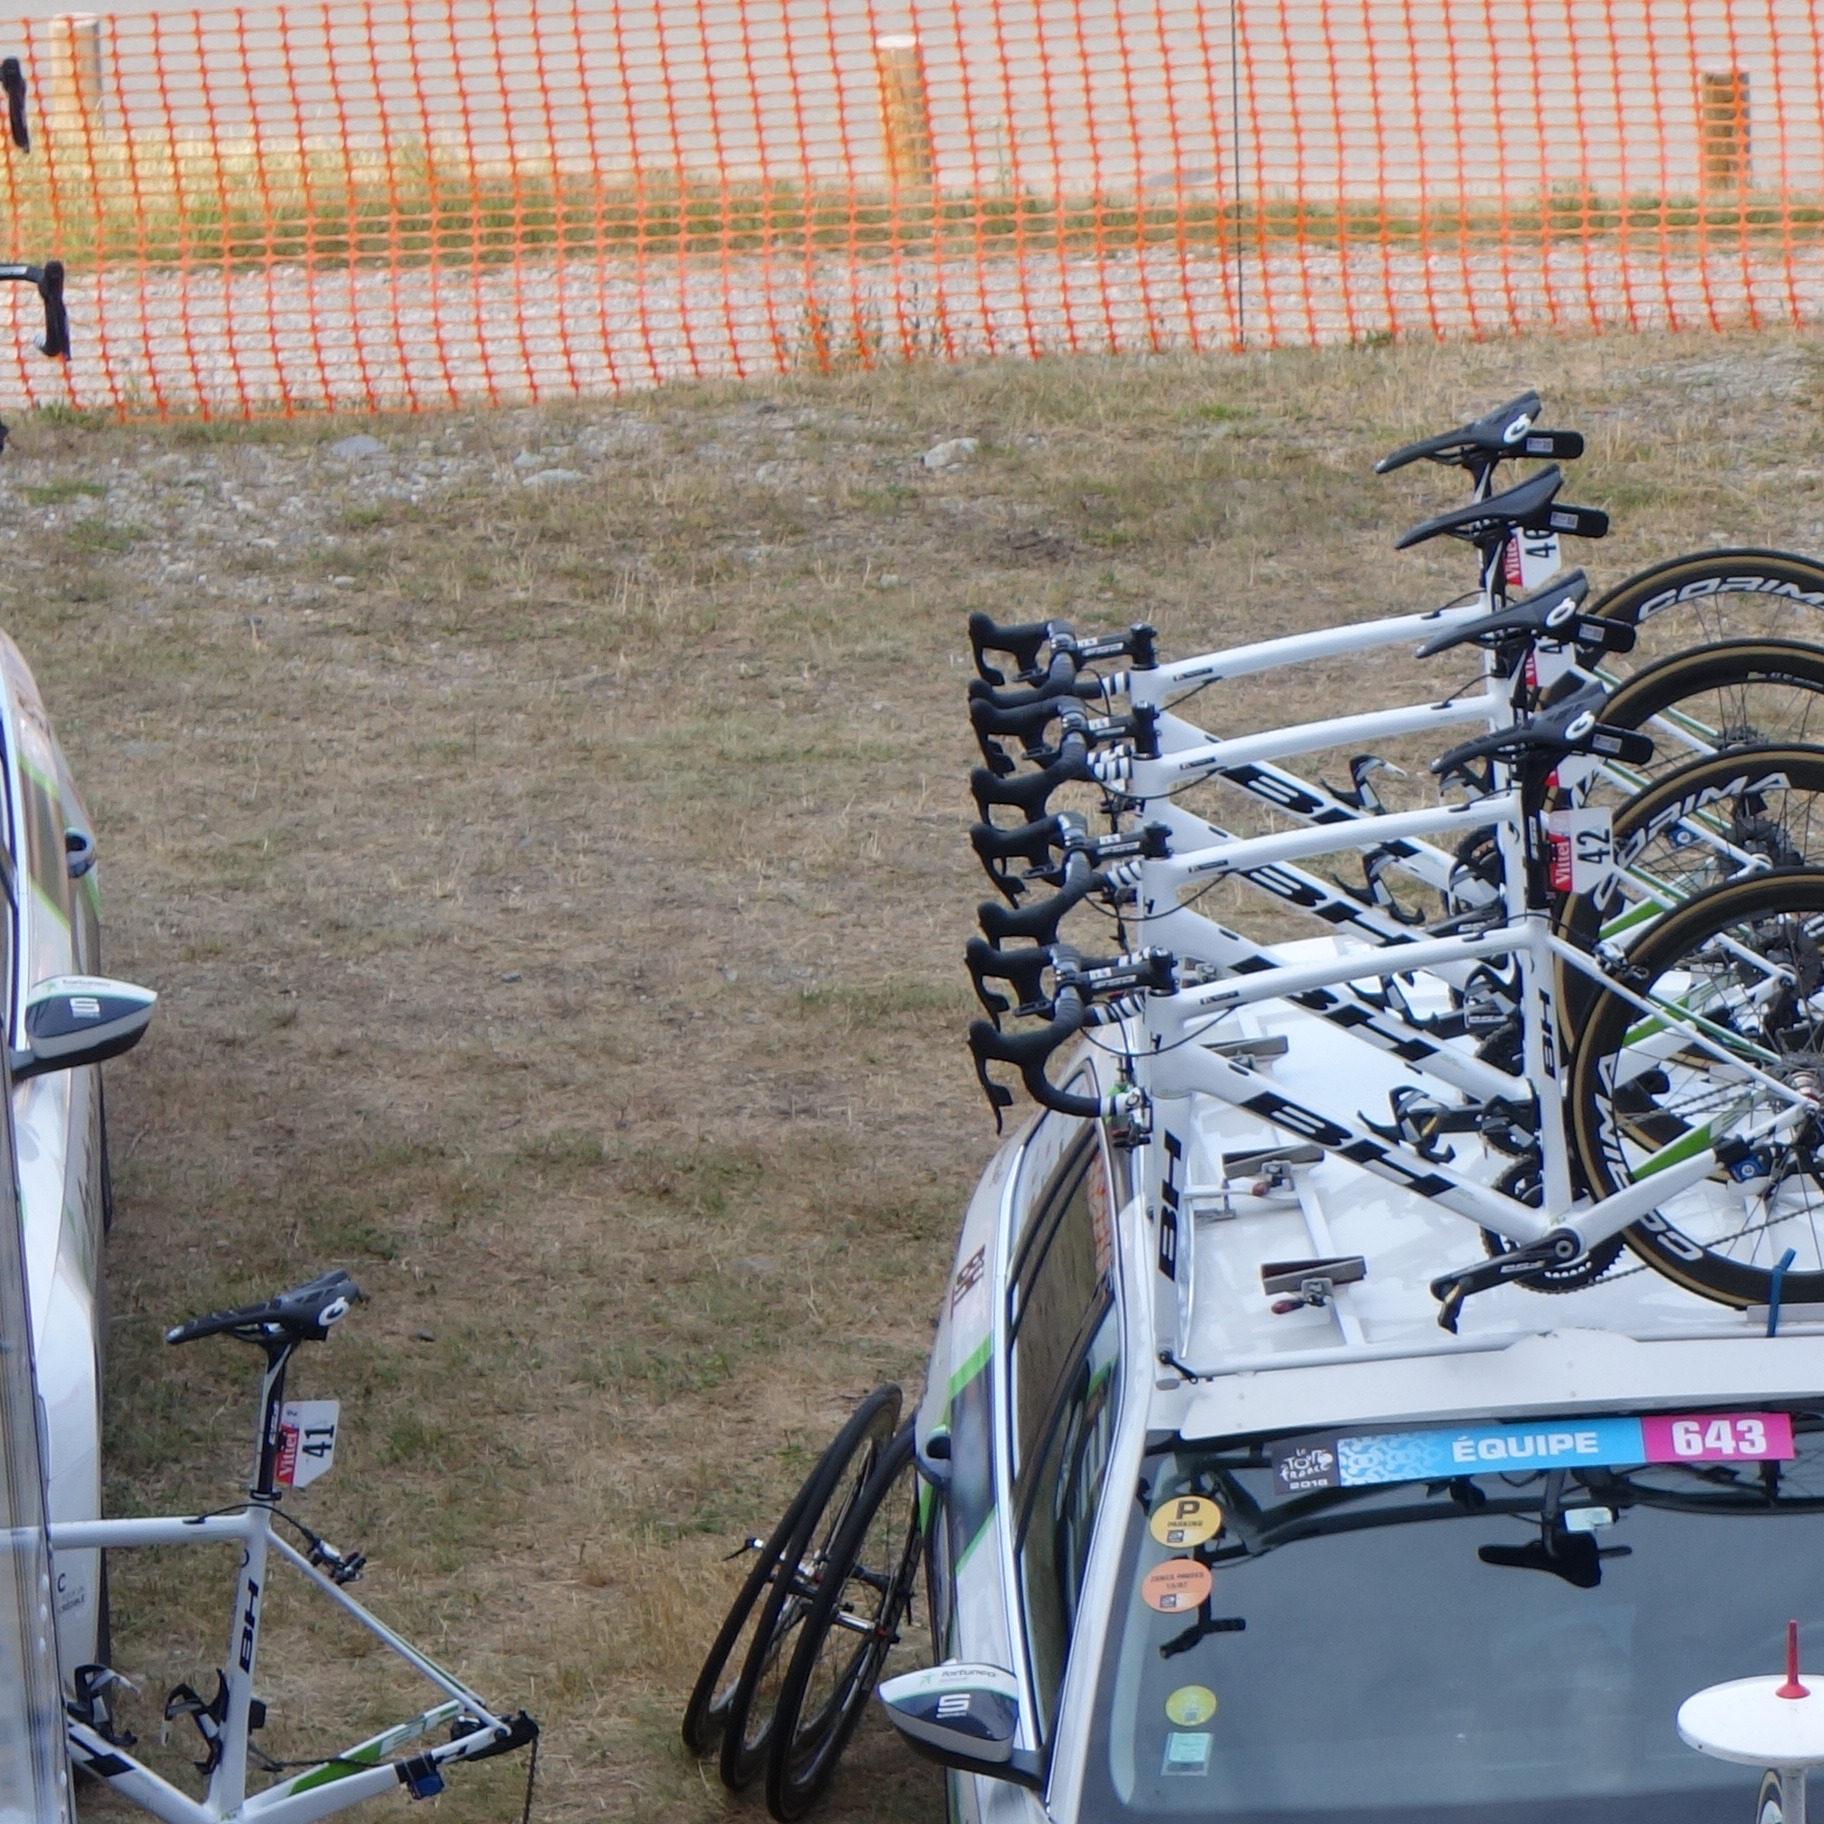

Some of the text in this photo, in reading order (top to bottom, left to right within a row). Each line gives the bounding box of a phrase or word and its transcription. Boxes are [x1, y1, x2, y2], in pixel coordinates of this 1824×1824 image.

[1576, 826, 1612, 866] 42
[1538, 986, 1557, 1080] BH
[1240, 1090, 1458, 1198] BH
[1157, 1128, 1182, 1283] BH
[301, 1423, 337, 1460] 41
[1451, 1418, 1768, 1465] ÉQUIPE 643
[1175, 1500, 1201, 1520] P
[239, 1577, 259, 1674] BH
